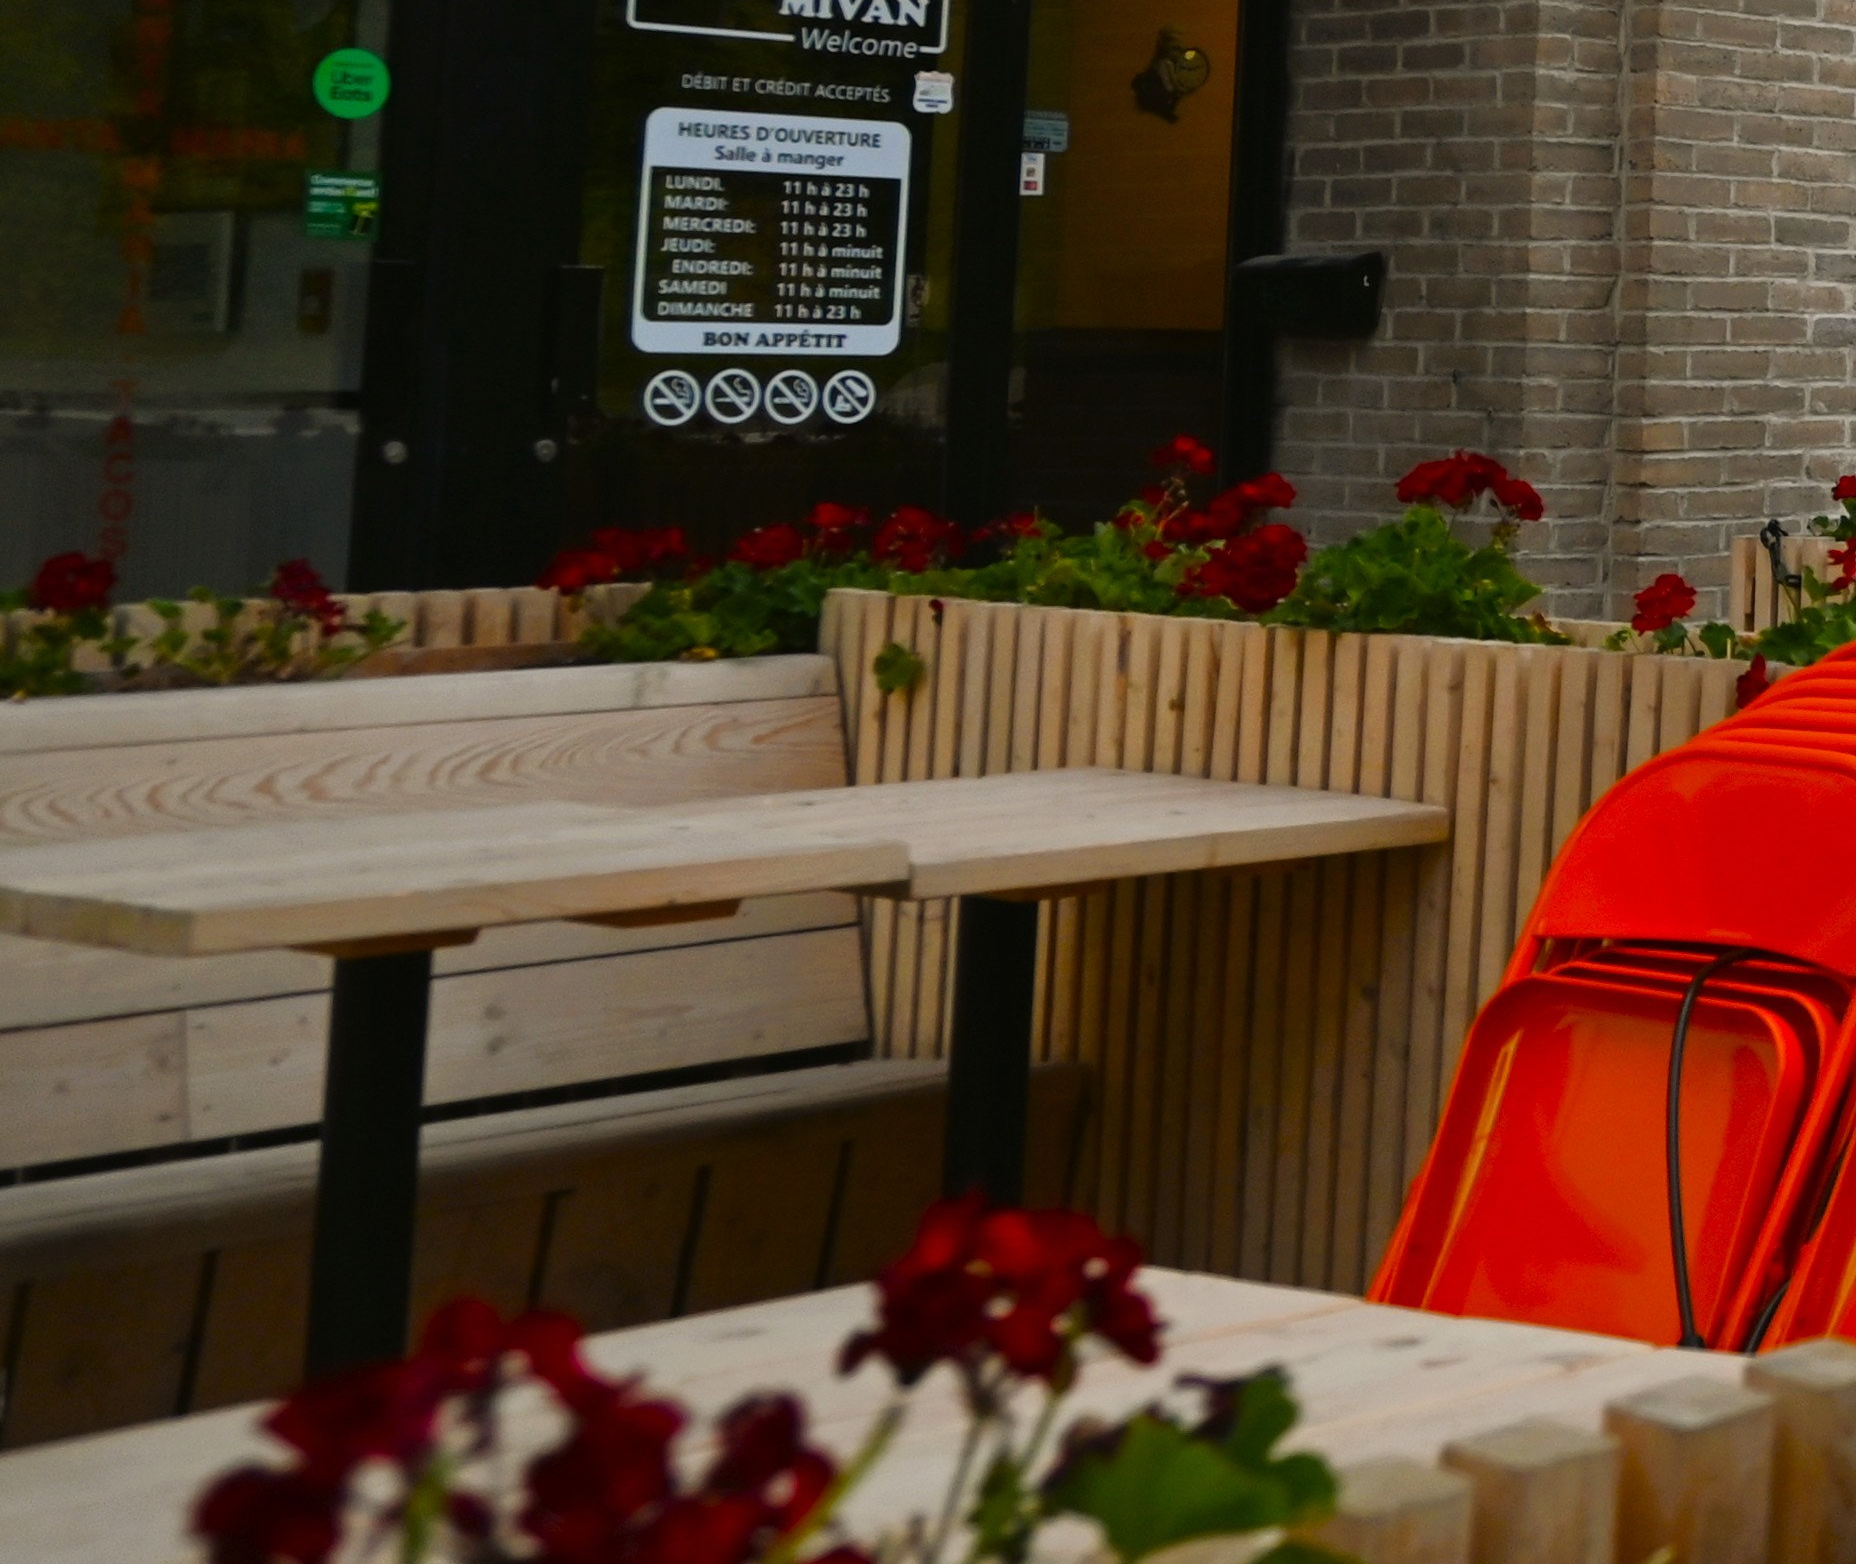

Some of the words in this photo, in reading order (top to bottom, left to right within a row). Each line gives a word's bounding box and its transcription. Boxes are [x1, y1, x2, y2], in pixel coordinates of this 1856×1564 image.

[800, 27, 919, 59] Welcome
[681, 72, 728, 92] DÉBIT
[732, 76, 752, 92] ET
[754, 76, 811, 96] CRÉDIT
[815, 82, 891, 104] ACCEPTÉS
[678, 122, 750, 141] HEURES
[756, 126, 882, 148] D'OUVERTURE
[714, 145, 755, 163] Salle
[762, 147, 772, 163] à
[777, 151, 844, 170] manger
[783, 181, 801, 195] 11
[807, 182, 818, 196] h
[835, 184, 855, 197] 23
[859, 185, 870, 198] h
[781, 200, 799, 214] 11
[804, 202, 816, 215] h
[833, 203, 853, 217] 23
[857, 204, 868, 218] h
[780, 221, 798, 234] 11
[803, 222, 815, 235] h
[832, 223, 852, 237] 23
[856, 224, 867, 238] h
[780, 242, 798, 256] 11
[803, 243, 814, 256] h
[832, 244, 883, 259] minuit
[779, 263, 797, 276] 11
[802, 264, 813, 277] h
[831, 265, 883, 280] minuit
[777, 283, 795, 297] 11
[800, 284, 811, 298] h
[829, 285, 880, 300] minuit
[657, 302, 754, 318] DIMANCHE
[774, 304, 793, 318] 11
[798, 305, 809, 318] h
[826, 305, 846, 319] 23
[850, 306, 861, 319] h
[703, 332, 749, 347] BON
